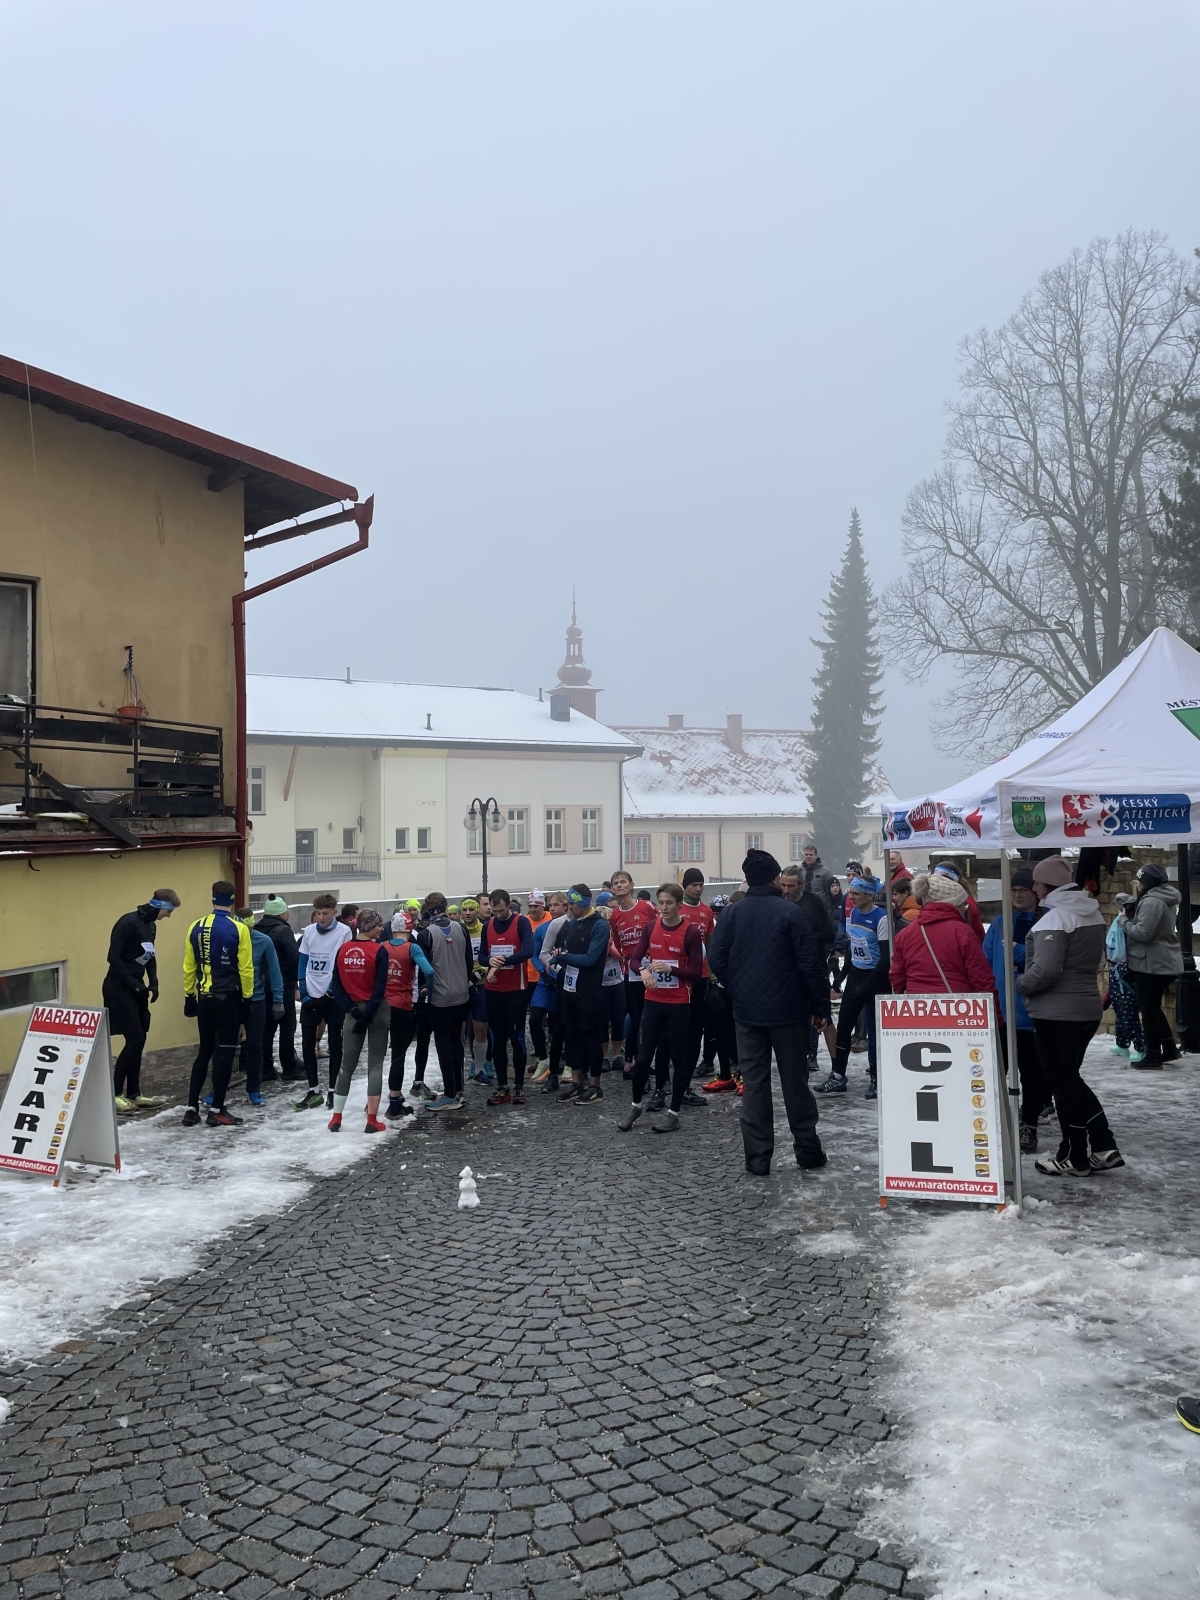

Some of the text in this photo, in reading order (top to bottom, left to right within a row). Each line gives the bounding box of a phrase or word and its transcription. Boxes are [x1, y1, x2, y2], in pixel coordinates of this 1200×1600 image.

[1165, 699, 1200, 709] MĚS
[1122, 796, 1159, 807] ČESKÝ
[1122, 807, 1188, 819] ATLETICKÝ
[1122, 821, 1155, 831] SVAZ
[853, 946, 865, 957] 48
[310, 960, 327, 971] 127
[607, 968, 617, 977] 41
[657, 971, 673, 983] 38
[881, 999, 988, 1017] MARATON
[33, 1007, 101, 1027] MARATON
[957, 1018, 984, 1026] stav
[76, 1026, 95, 1036] stav
[967, 1029, 989, 1037] Úpice
[11, 1045, 61, 1155] START
[900, 1042, 953, 1174] CÍL
[889, 1179, 995, 1193] www.maratonstav.cz
